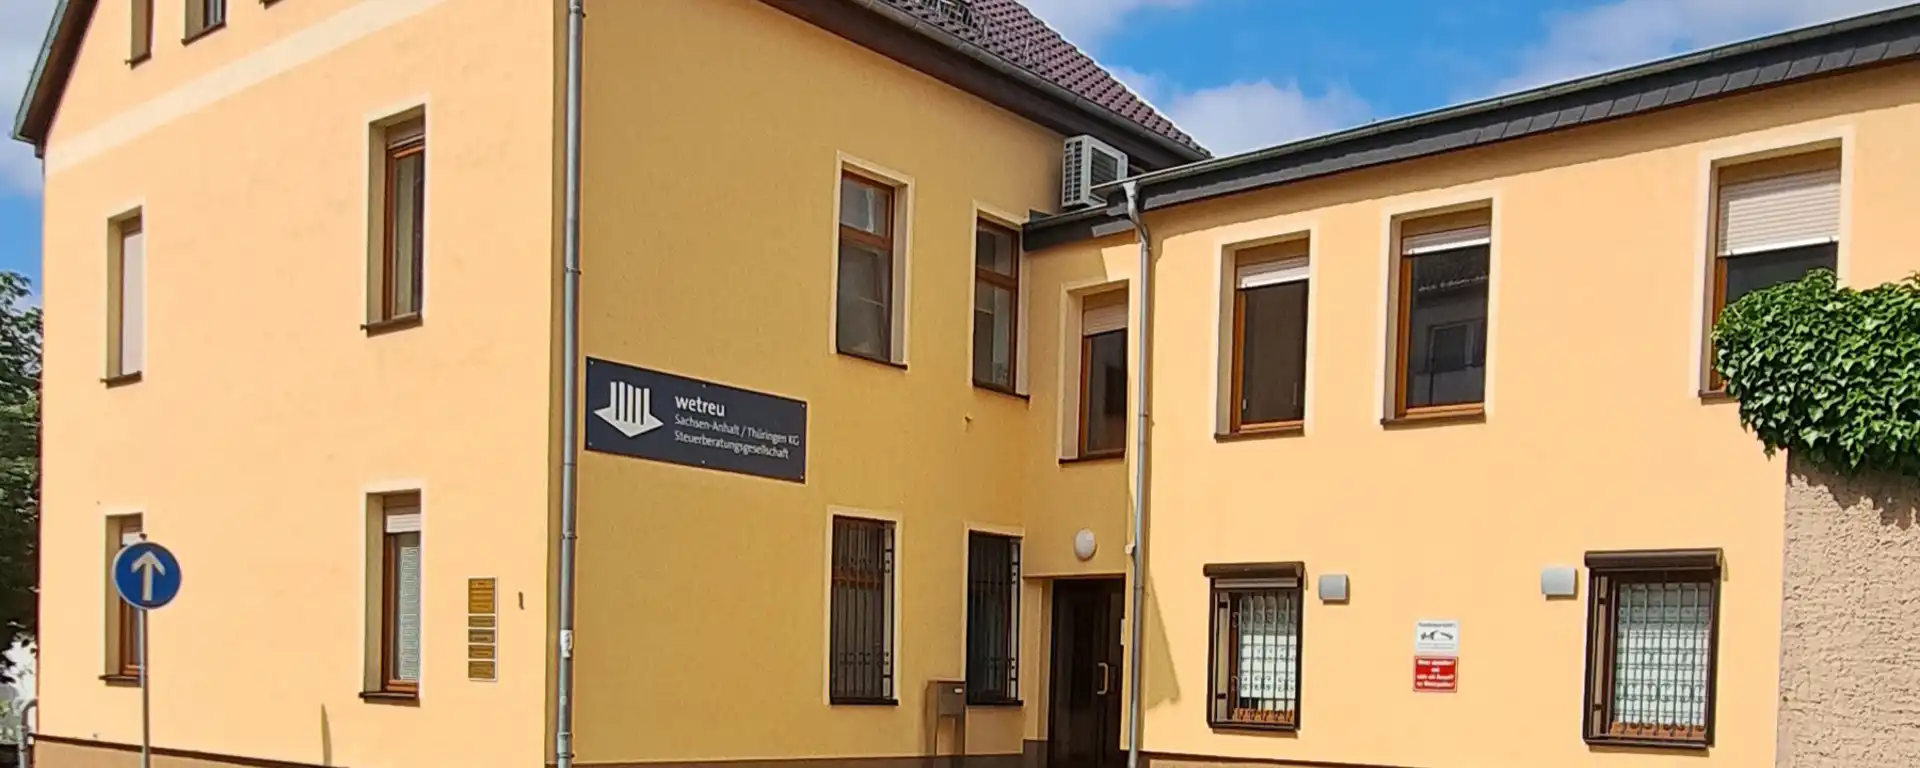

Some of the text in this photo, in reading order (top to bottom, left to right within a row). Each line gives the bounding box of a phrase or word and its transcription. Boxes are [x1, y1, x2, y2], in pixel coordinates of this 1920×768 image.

[675, 395, 725, 417] wetreu
[674, 430, 788, 458] Steuerberatungsgesellschaft
[675, 414, 740, 435] Sachsen-Anhalt
[747, 427, 787, 445] Thüringen
[788, 435, 799, 446] KG
